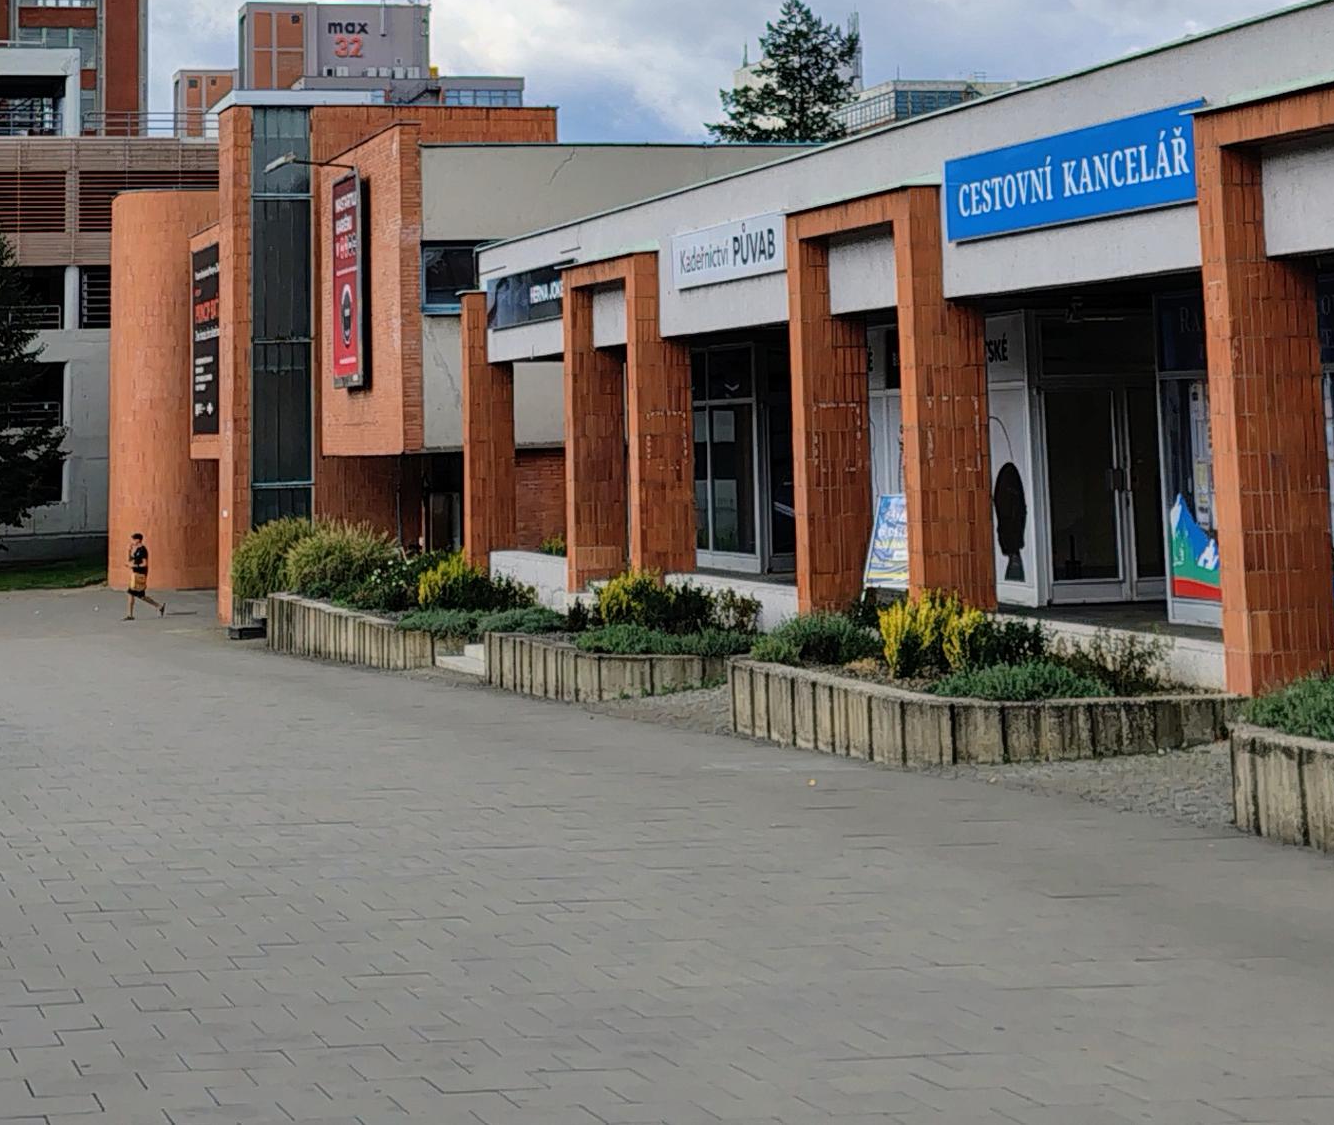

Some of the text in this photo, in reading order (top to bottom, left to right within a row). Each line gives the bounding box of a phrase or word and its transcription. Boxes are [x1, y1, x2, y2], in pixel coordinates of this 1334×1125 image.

[328, 22, 368, 34] max
[335, 34, 364, 58] 32
[958, 128, 1190, 217] CESTOVNÍ KANCELÁŘ
[680, 222, 776, 275] Kadeřnictví PŮVAB
[985, 332, 1008, 363] SKÉ
